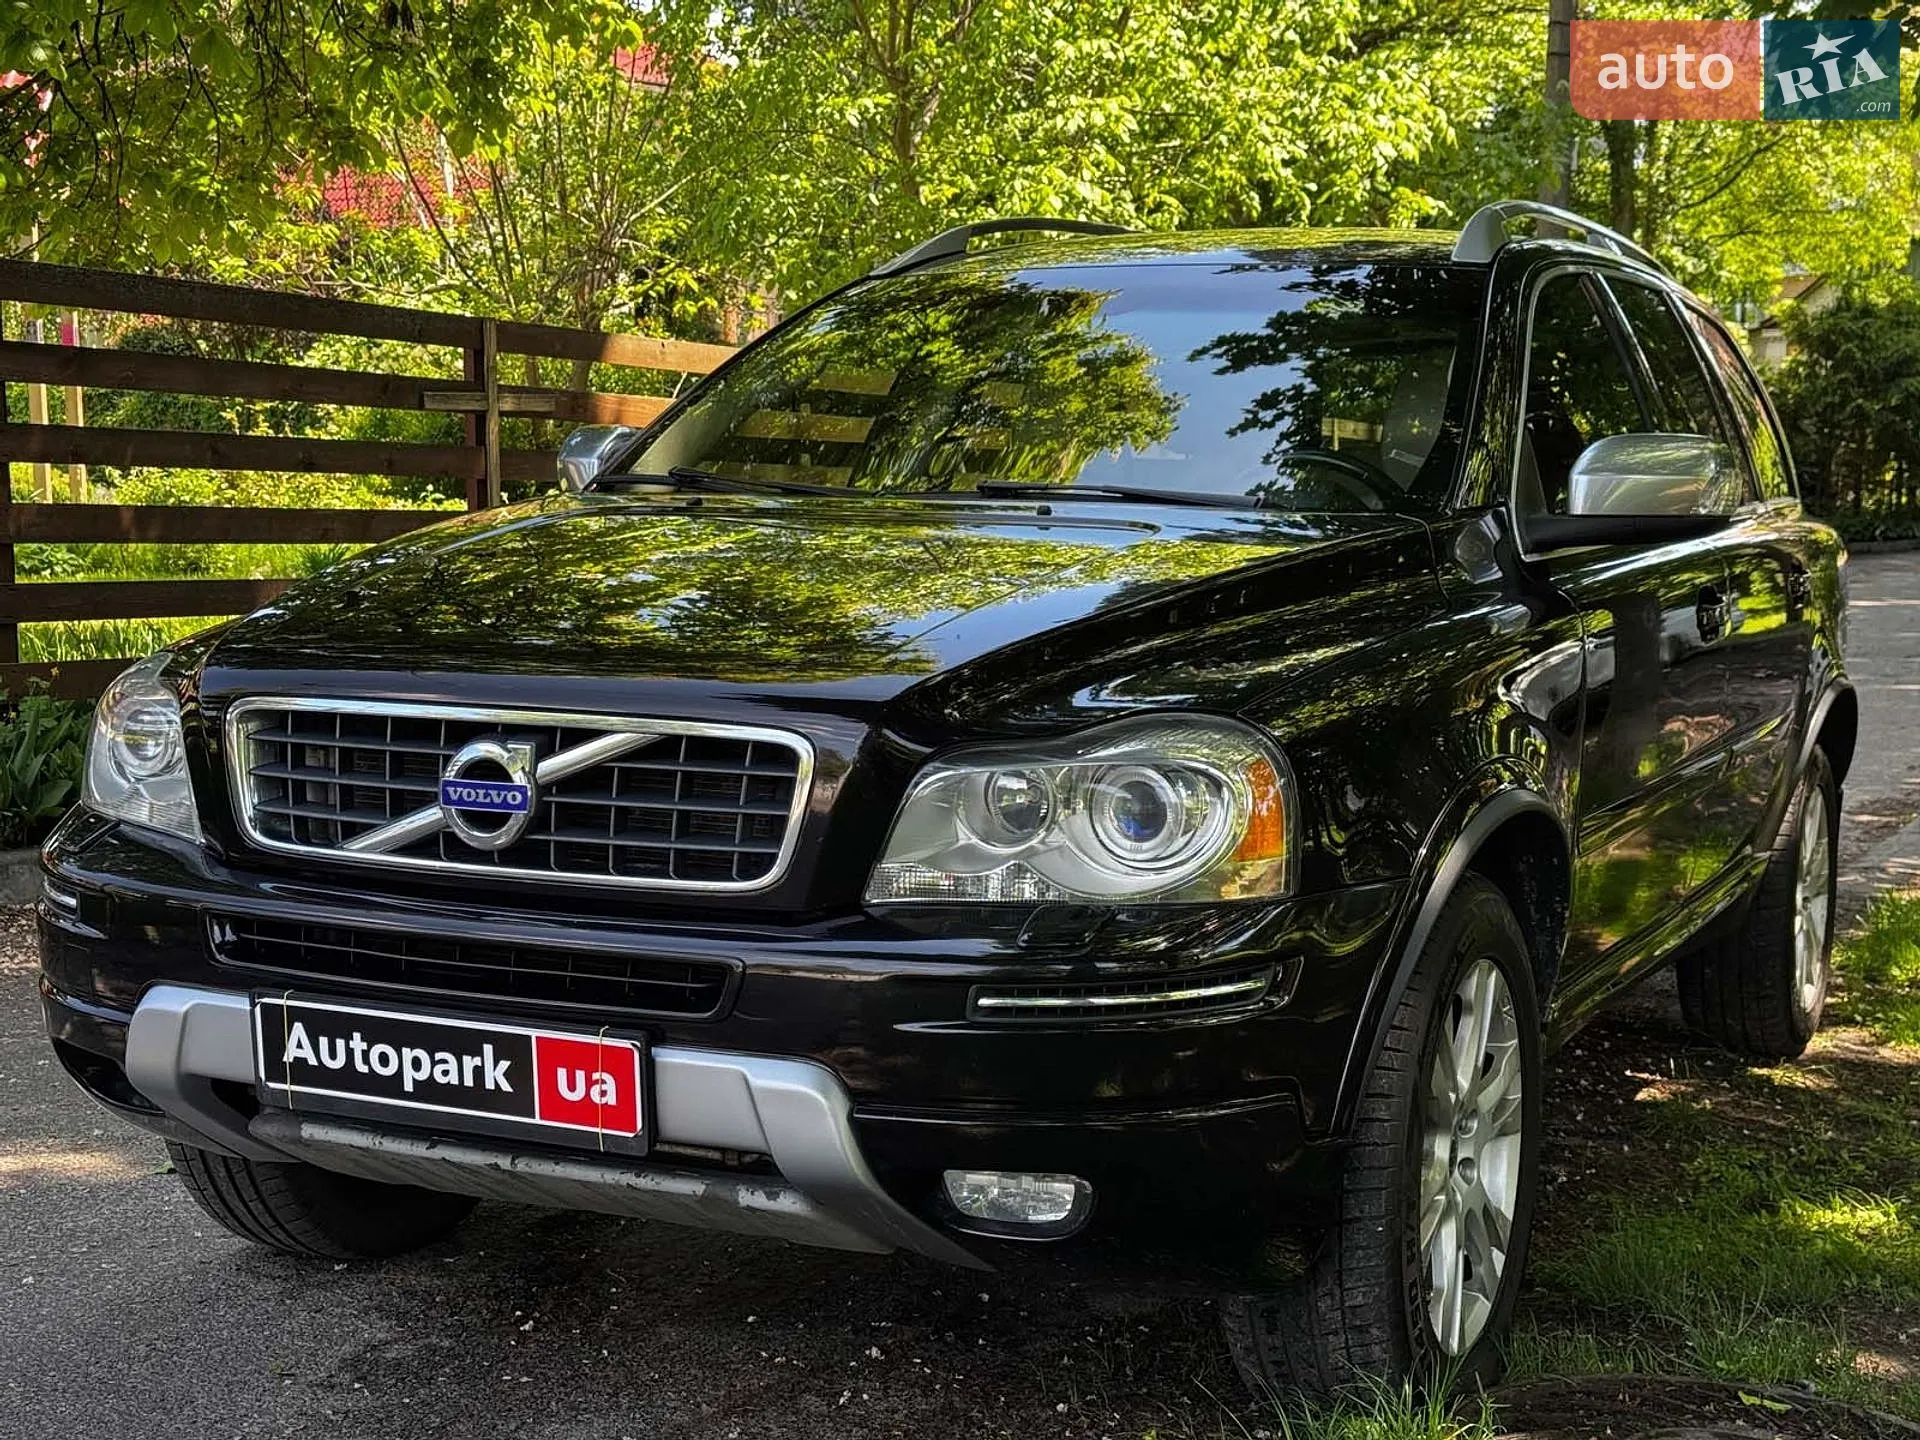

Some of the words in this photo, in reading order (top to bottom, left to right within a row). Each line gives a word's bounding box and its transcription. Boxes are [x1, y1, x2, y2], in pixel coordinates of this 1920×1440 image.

[446, 786, 523, 805] VOLVO
[282, 1021, 514, 1093] Autopark
[556, 1066, 618, 1106] ua
